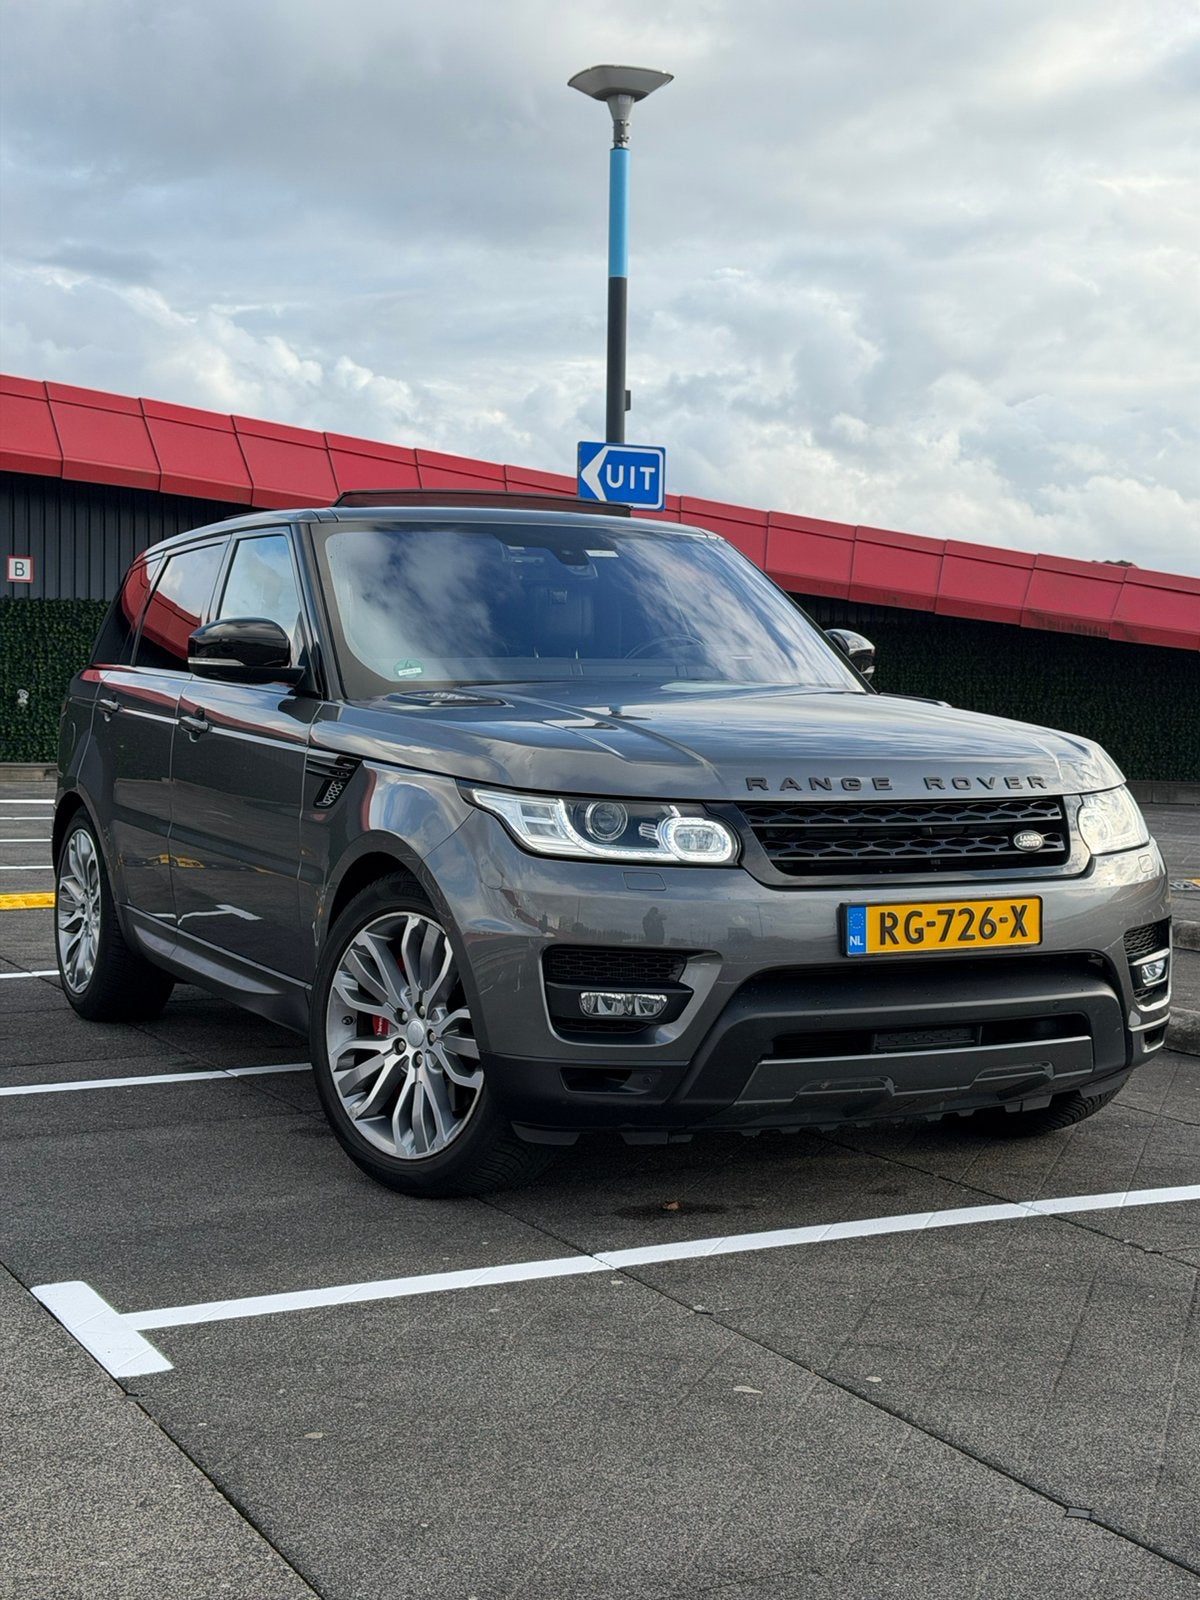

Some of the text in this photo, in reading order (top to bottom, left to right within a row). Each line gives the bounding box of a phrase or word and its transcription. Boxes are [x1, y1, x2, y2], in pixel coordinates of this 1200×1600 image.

[606, 464, 656, 491] UIT
[14, 561, 25, 577] B
[745, 776, 1047, 791] RANGE ROVER
[879, 904, 1028, 946] RG-726-X
[850, 935, 864, 946] NL
